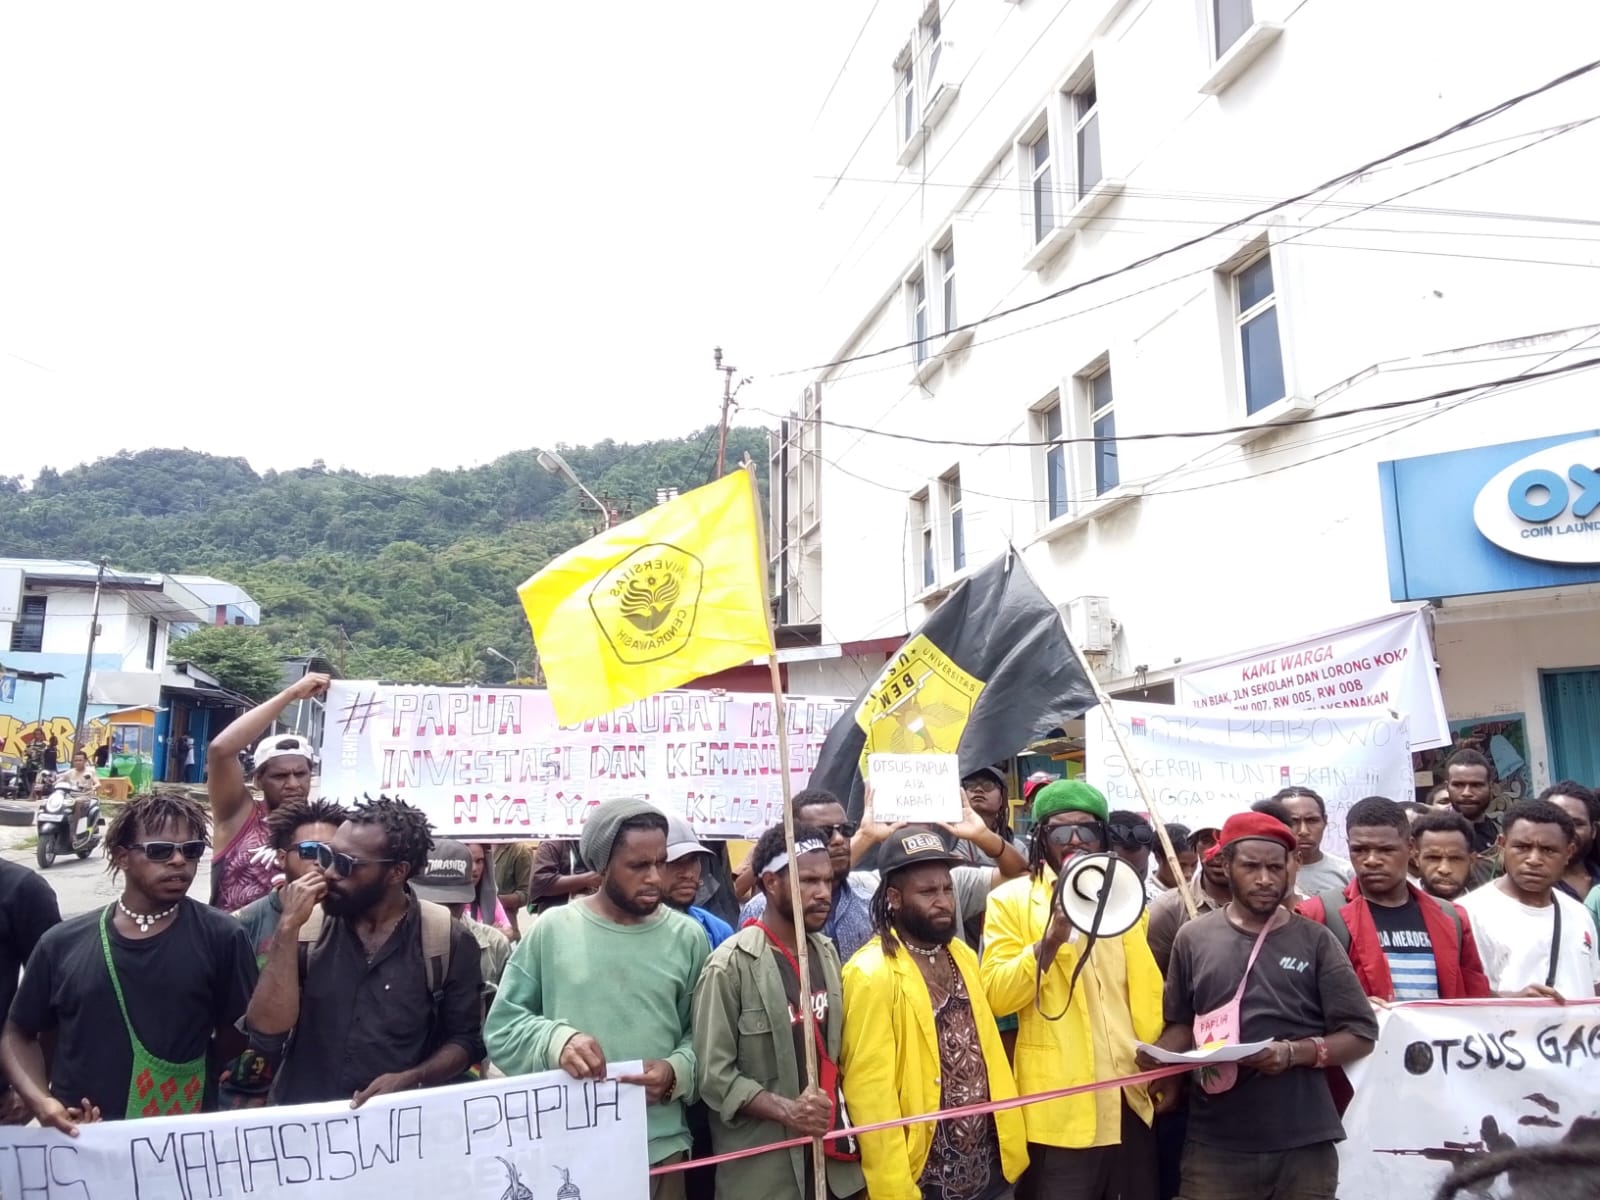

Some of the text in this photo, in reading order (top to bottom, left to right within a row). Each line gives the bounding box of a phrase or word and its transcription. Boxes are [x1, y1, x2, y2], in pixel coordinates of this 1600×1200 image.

[1520, 525, 1553, 539] COIN
[922, 647, 977, 692] UNIVERSITAS
[1233, 687, 1250, 702] JLN
[1250, 676, 1295, 697] SEKOLAH
[1296, 670, 1319, 686] DAN
[1321, 658, 1372, 681] LORONG
[1241, 645, 1333, 682] KAMI WARGA
[879, 672, 915, 710] BEM
[1273, 695, 1291, 710] RW
[1317, 684, 1337, 699] RW
[1339, 678, 1364, 694] 008
[391, 693, 523, 737] PAPUA
[558, 694, 735, 735] RURAT
[749, 701, 852, 738] MLIT
[1227, 716, 1392, 749] PRABOWO
[380, 744, 573, 790] INVESTASI
[589, 744, 646, 780] DAN
[872, 759, 949, 776] OTSUS PAPUA
[453, 791, 531, 826] NYA
[1404, 1029, 1526, 1076] OTSUS
[131, 1104, 424, 1200] MAHASISWA
[464, 1076, 621, 1155] PAPUA
